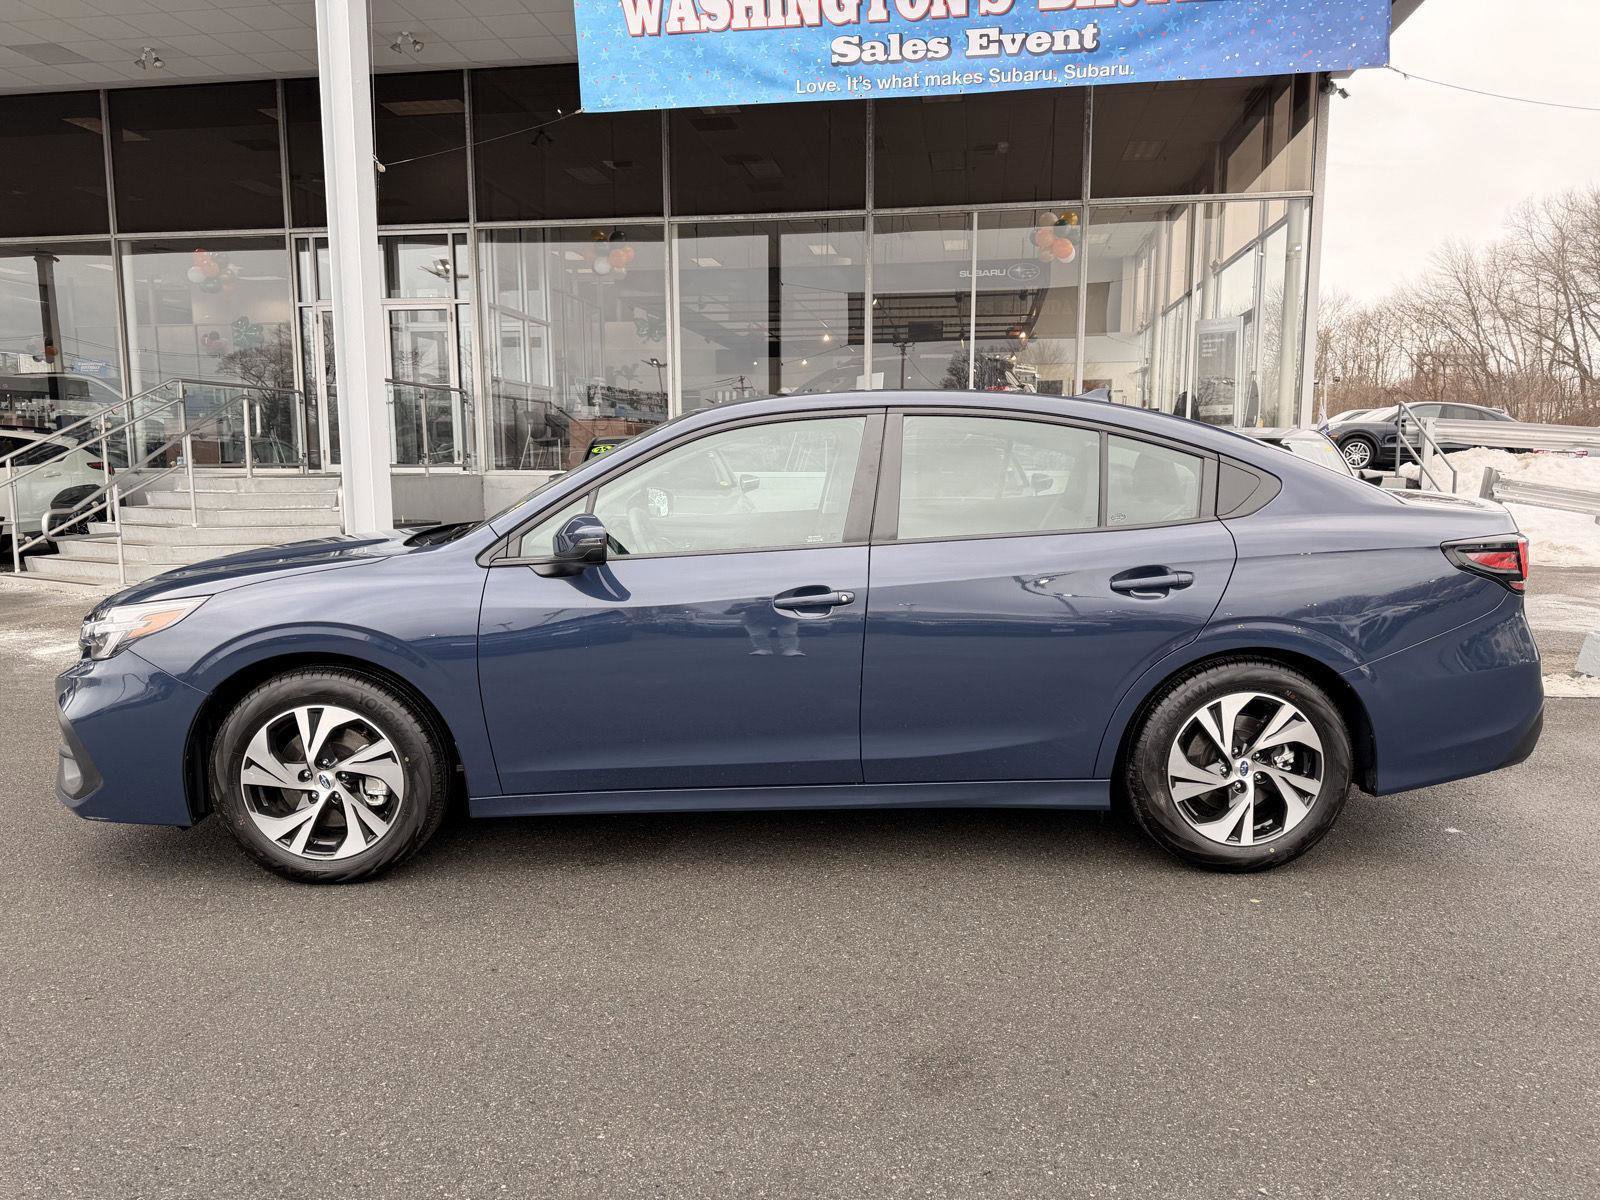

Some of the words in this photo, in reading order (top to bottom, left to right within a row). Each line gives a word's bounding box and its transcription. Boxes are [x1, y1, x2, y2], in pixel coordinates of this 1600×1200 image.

[620, 0, 1013, 37] WASHING
[831, 33, 951, 65] Sales
[966, 23, 1099, 58] Event
[796, 79, 841, 94] Love.
[847, 76, 872, 91] It's
[877, 73, 919, 89] what
[925, 70, 983, 87] makes
[989, 67, 1058, 83] Subaru,
[1064, 63, 1135, 79] Subaru.
[959, 268, 1006, 278] SUBARU
